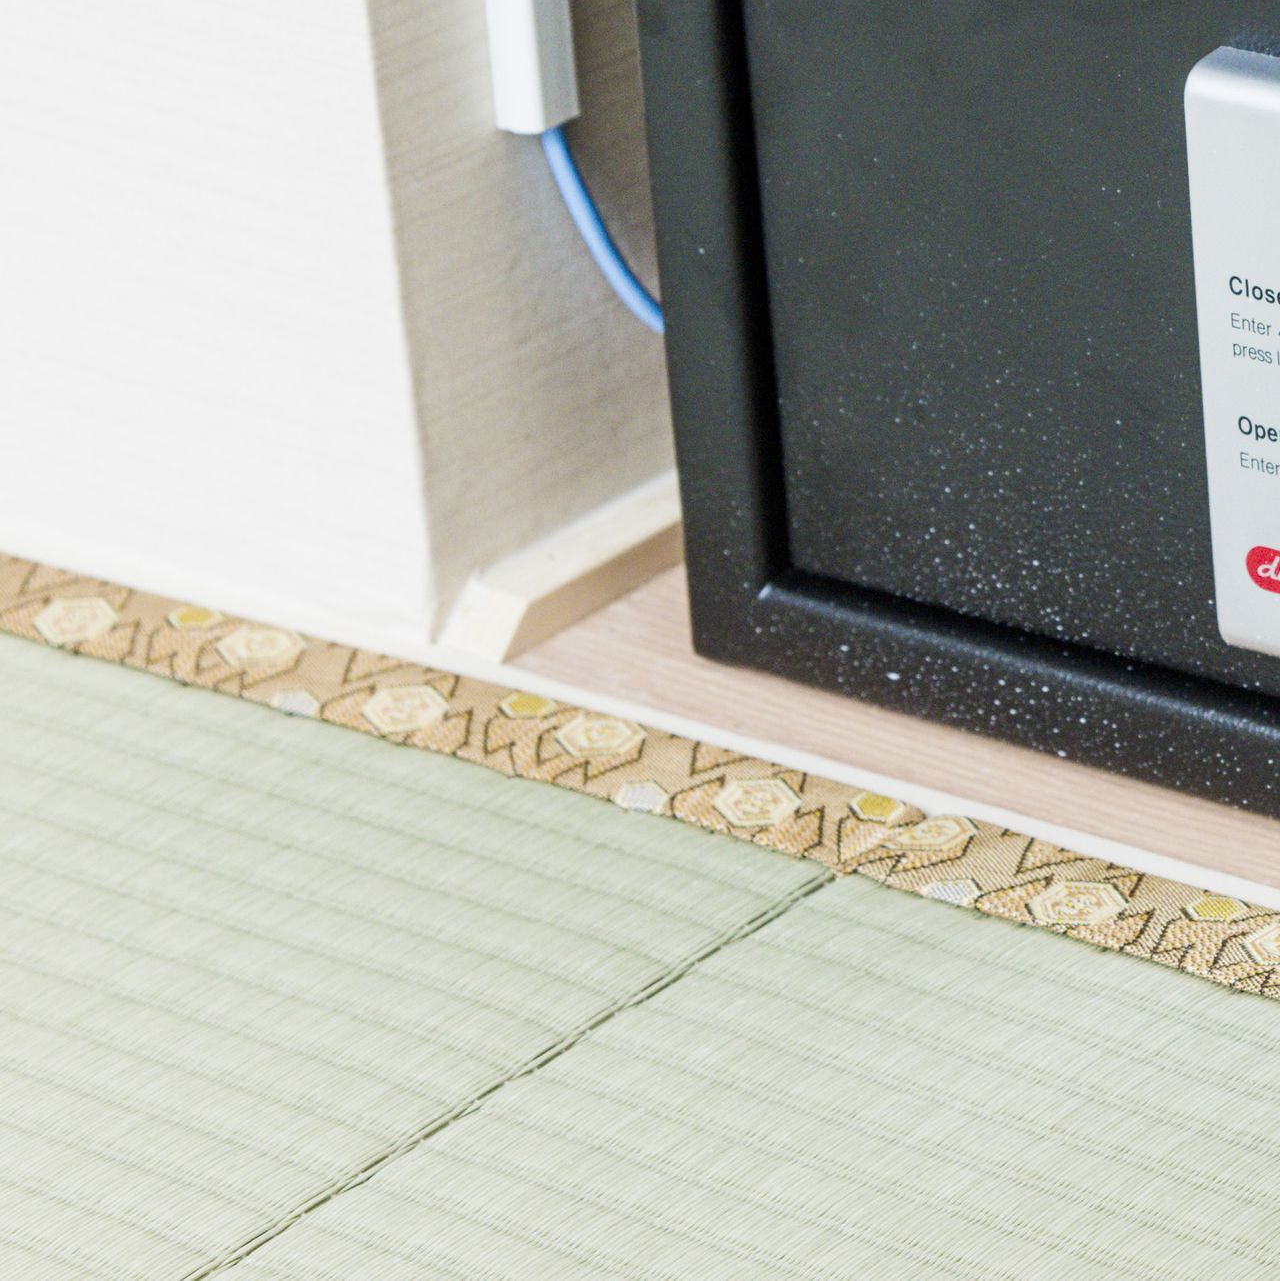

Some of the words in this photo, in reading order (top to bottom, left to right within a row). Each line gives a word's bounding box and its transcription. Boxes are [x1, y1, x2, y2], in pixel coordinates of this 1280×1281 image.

[1230, 312, 1271, 335] Enter
[1232, 343, 1272, 364] press
[1239, 451, 1280, 475] Enter
